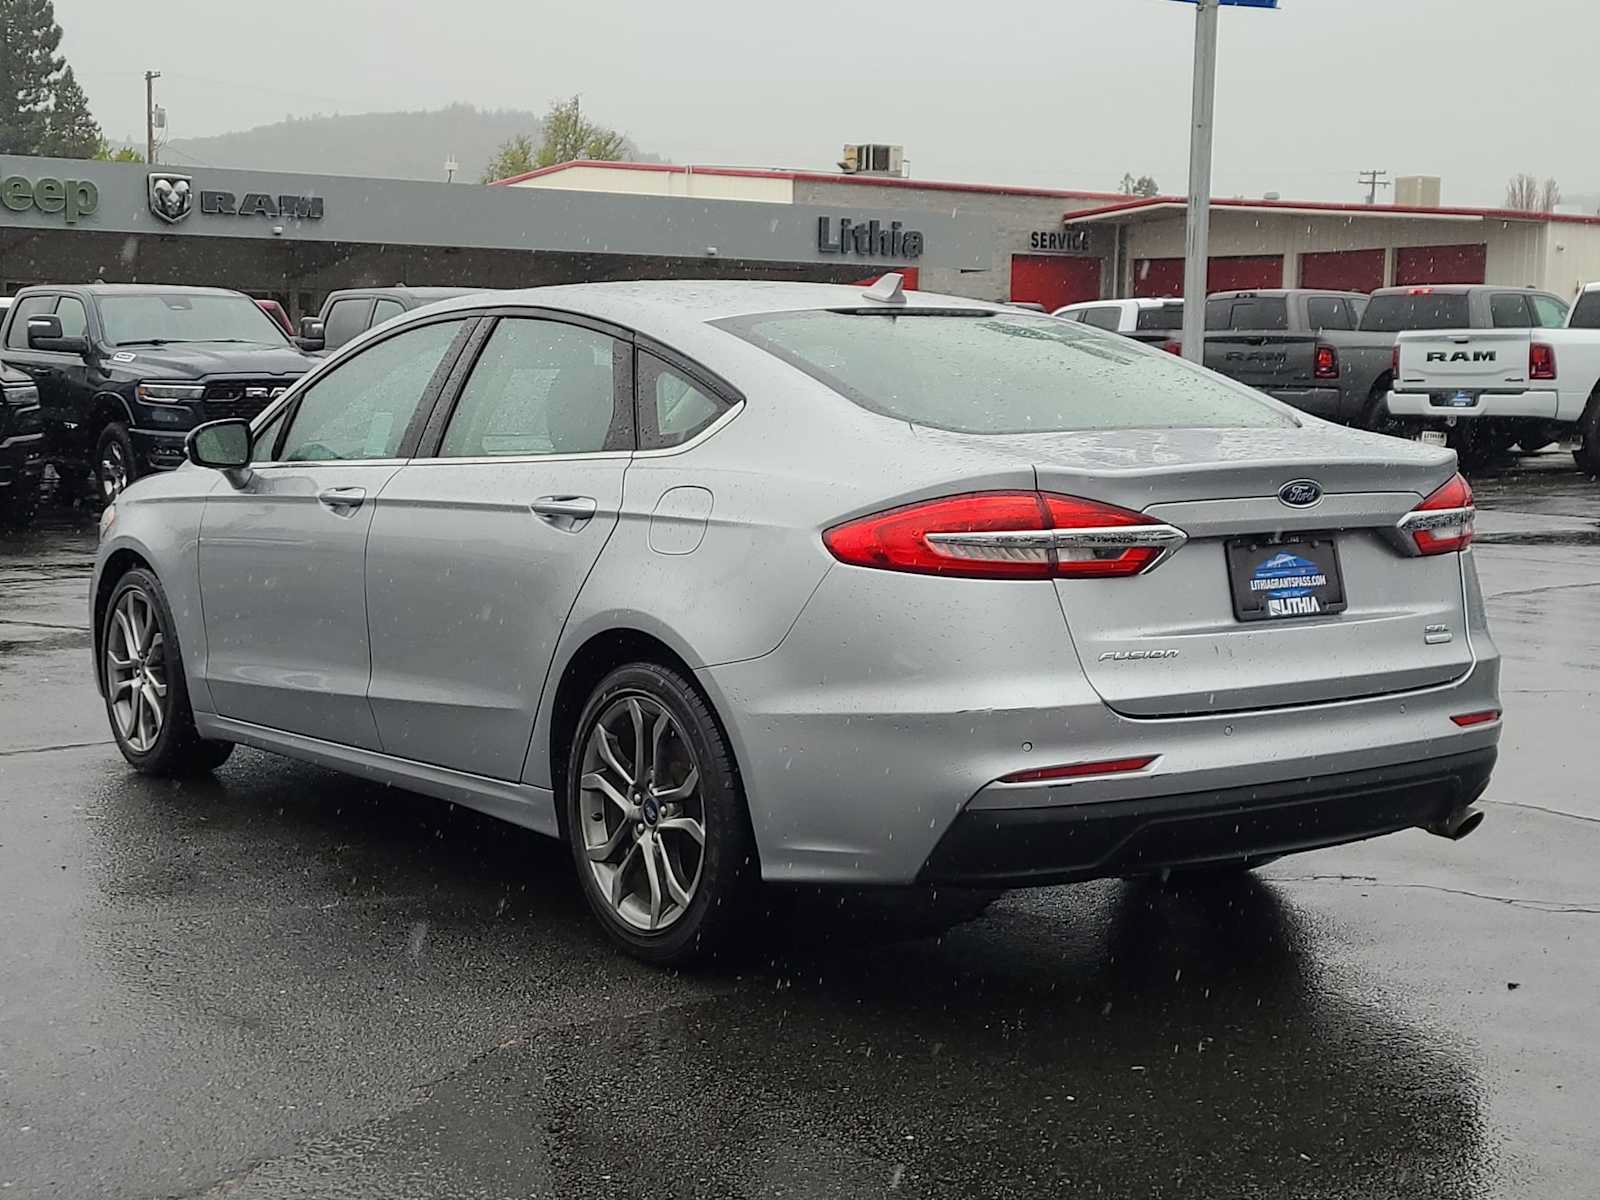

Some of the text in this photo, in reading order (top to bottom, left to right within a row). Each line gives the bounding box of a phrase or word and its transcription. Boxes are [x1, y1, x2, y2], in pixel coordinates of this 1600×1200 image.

[0, 175, 98, 224] eep
[200, 189, 323, 218] RAM
[817, 216, 924, 258] Lithia
[1030, 231, 1089, 251] SERVICE
[1225, 351, 1287, 362] RAM
[1426, 351, 1496, 362] RAM
[1289, 485, 1316, 502] Ford
[1249, 575, 1327, 591] LITHIAGRANTSPASS.COM
[1280, 596, 1321, 615] LITHIA
[1098, 649, 1180, 662] FUSION
